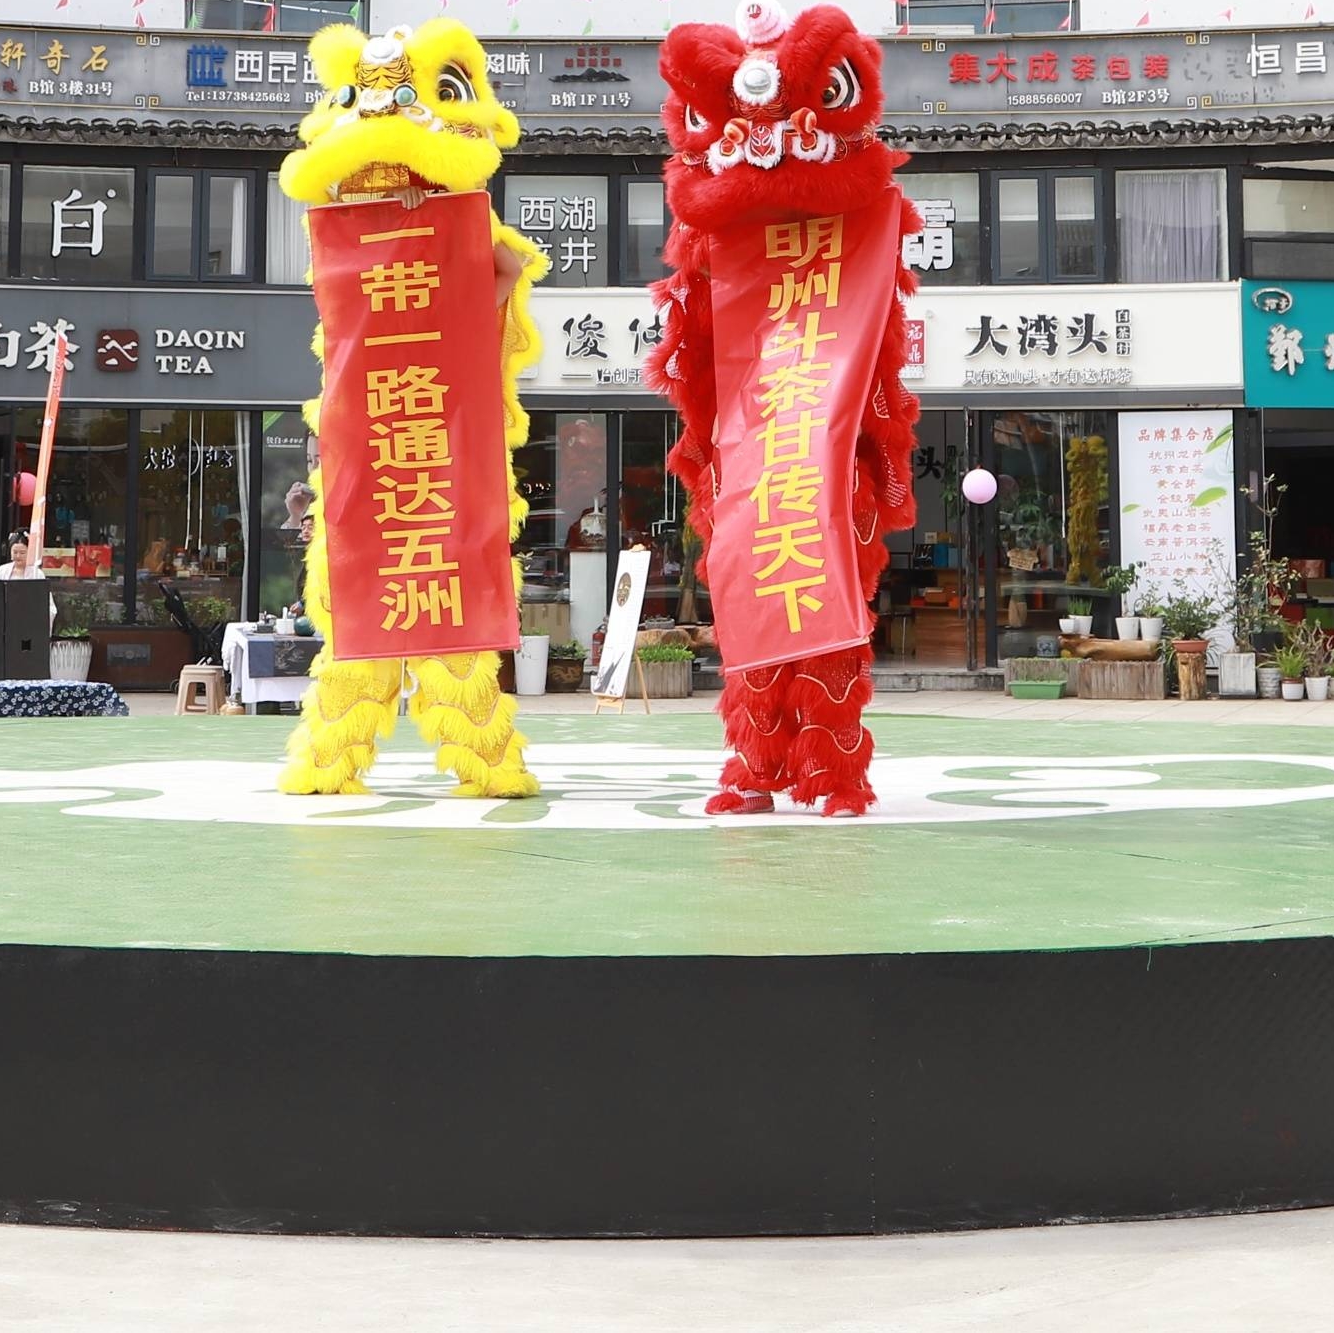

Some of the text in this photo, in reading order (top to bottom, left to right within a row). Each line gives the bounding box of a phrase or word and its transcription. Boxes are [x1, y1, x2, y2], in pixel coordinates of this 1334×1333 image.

[949, 52, 1170, 83] 集大成茶包装
[29, 79, 54, 95] B馆
[551, 93, 576, 107] B馆
[602, 93, 631, 107] 11号
[1007, 93, 1083, 105] 15888566007
[520, 196, 597, 232] 西湖
[155, 329, 245, 350] DAQIN
[966, 313, 1109, 357] 大湾头
[156, 355, 213, 375] TEA
[359, 226, 464, 633] 一带一路通达五洲
[749, 214, 843, 635] 明州斗茶甘传天下
[1138, 427, 1215, 442] 品牌集合店
